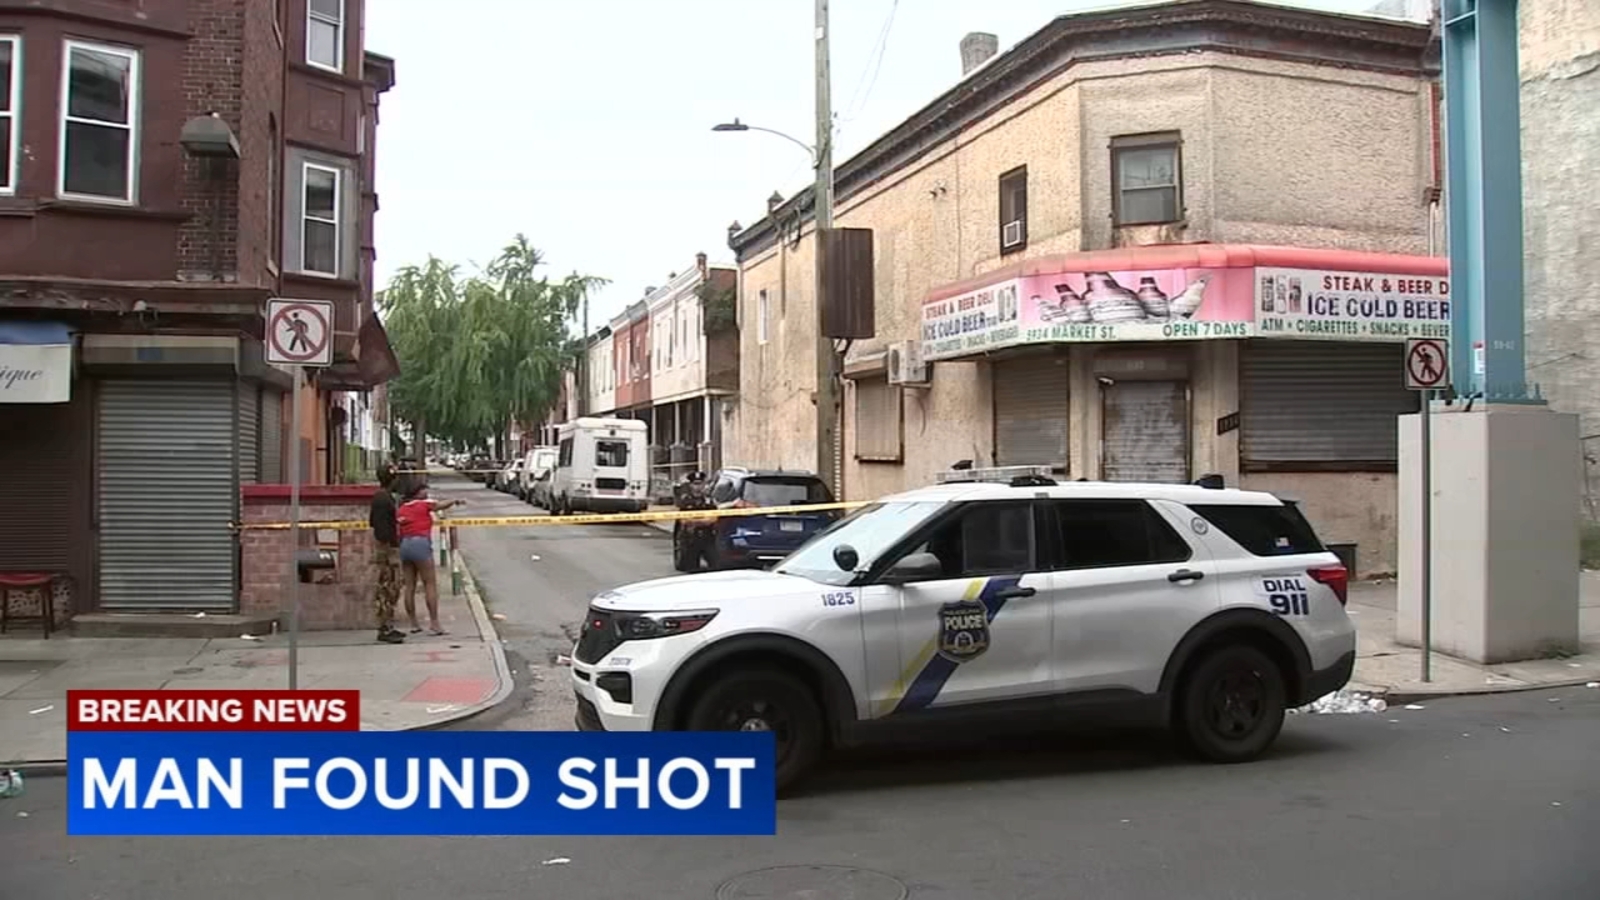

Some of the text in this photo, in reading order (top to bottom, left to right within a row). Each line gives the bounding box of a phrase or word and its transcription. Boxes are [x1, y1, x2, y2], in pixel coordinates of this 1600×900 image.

[1323, 275, 1374, 292] STEAK
[1381, 279, 1392, 293] &
[1399, 279, 1432, 294] BEER
[958, 295, 976, 312] BEER
[1308, 294, 1340, 315] ICE
[1346, 297, 1397, 318] COLD
[962, 311, 986, 333] BEER
[1162, 323, 1247, 337] OPEN 7 DAYS
[1261, 319, 1284, 331] ATM
[1296, 320, 1359, 334] CIGARETTES
[1370, 323, 1409, 335] SNACKS
[1051, 325, 1097, 339] MARKET
[1100, 325, 1117, 339] ST.
[1263, 580, 1305, 592] DIAL
[820, 591, 855, 607] 1825
[1271, 594, 1309, 615] 911
[944, 614, 983, 631] POLICE
